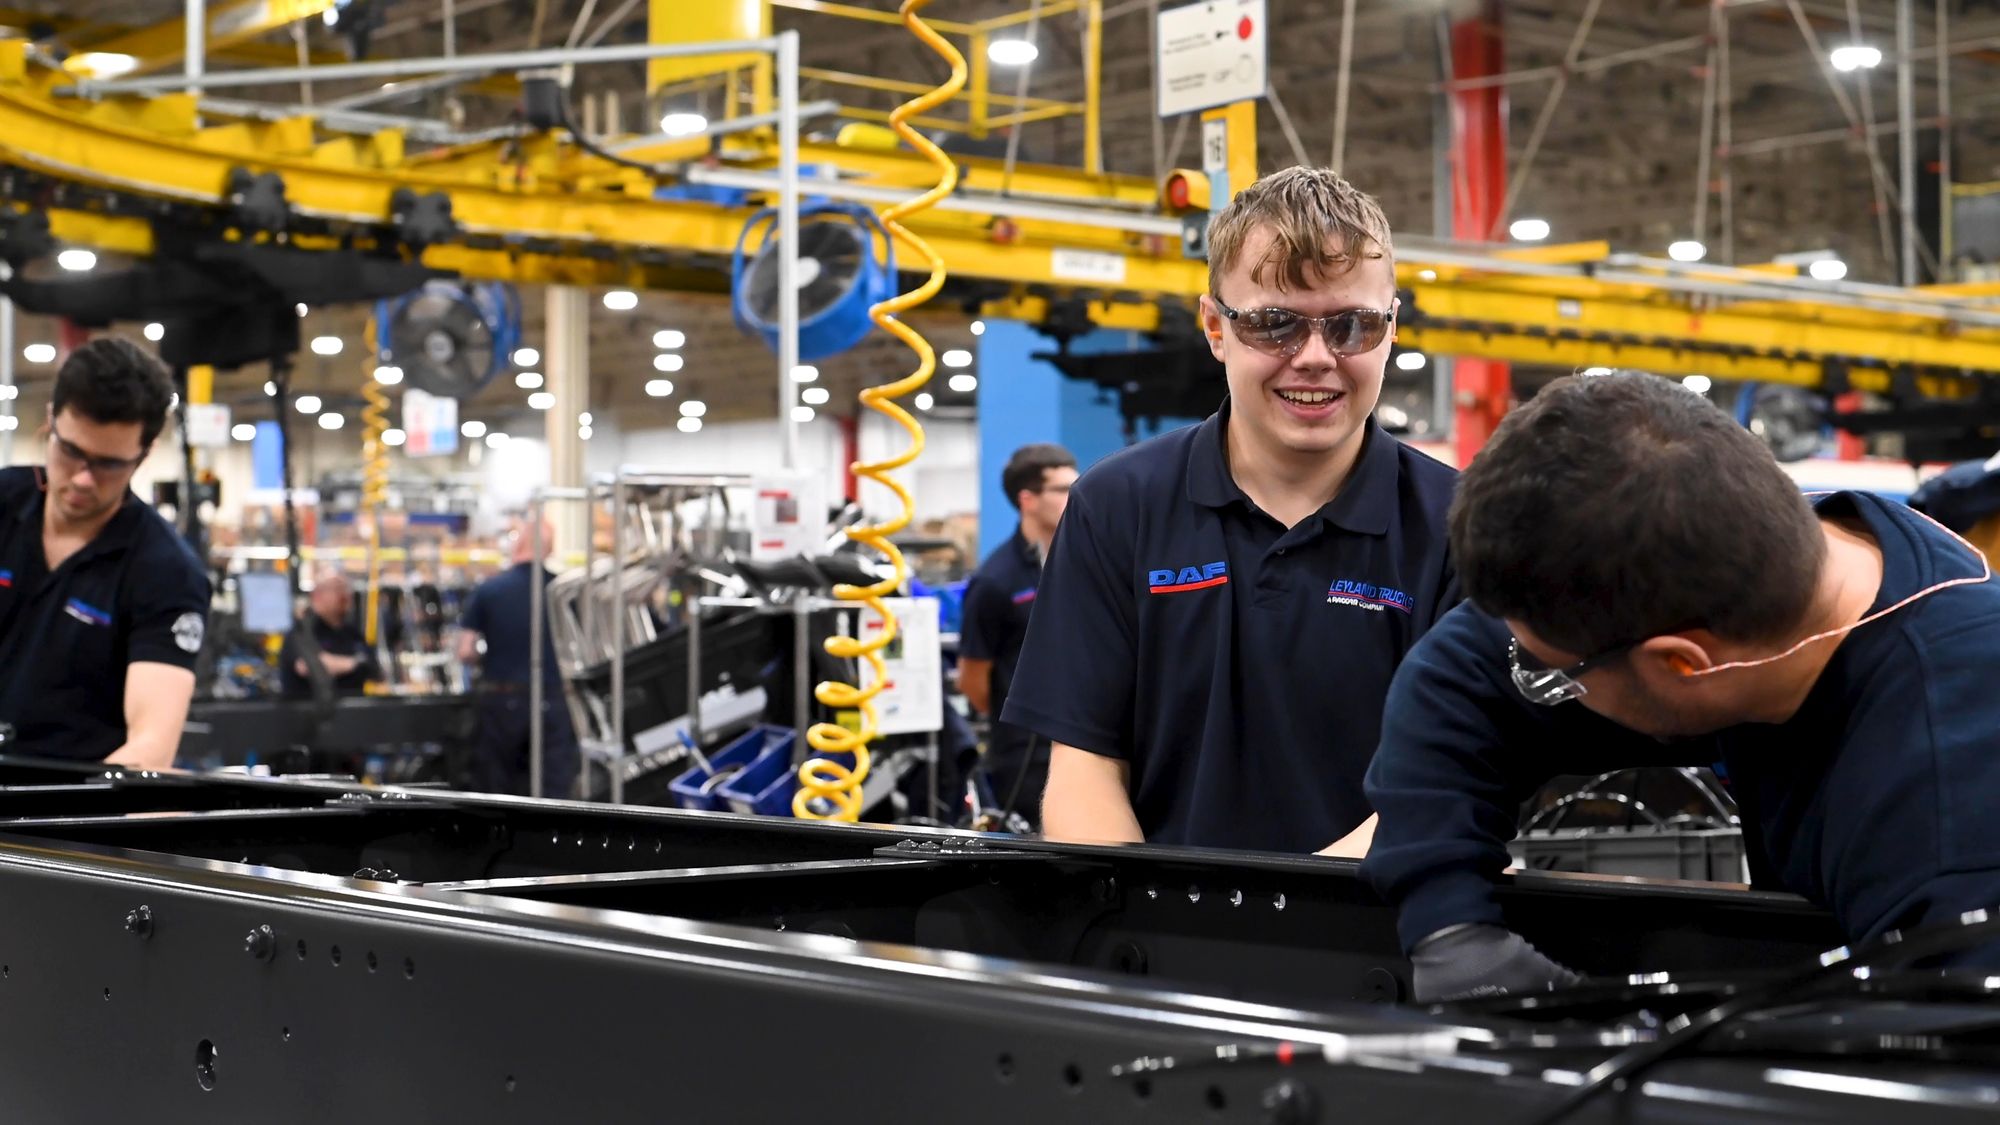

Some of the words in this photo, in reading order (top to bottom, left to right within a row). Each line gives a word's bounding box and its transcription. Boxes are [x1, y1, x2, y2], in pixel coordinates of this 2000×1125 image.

[1149, 562, 1226, 586] DAF
[1329, 580, 1377, 599] LEYLAND
[1326, 596, 1332, 604] A
